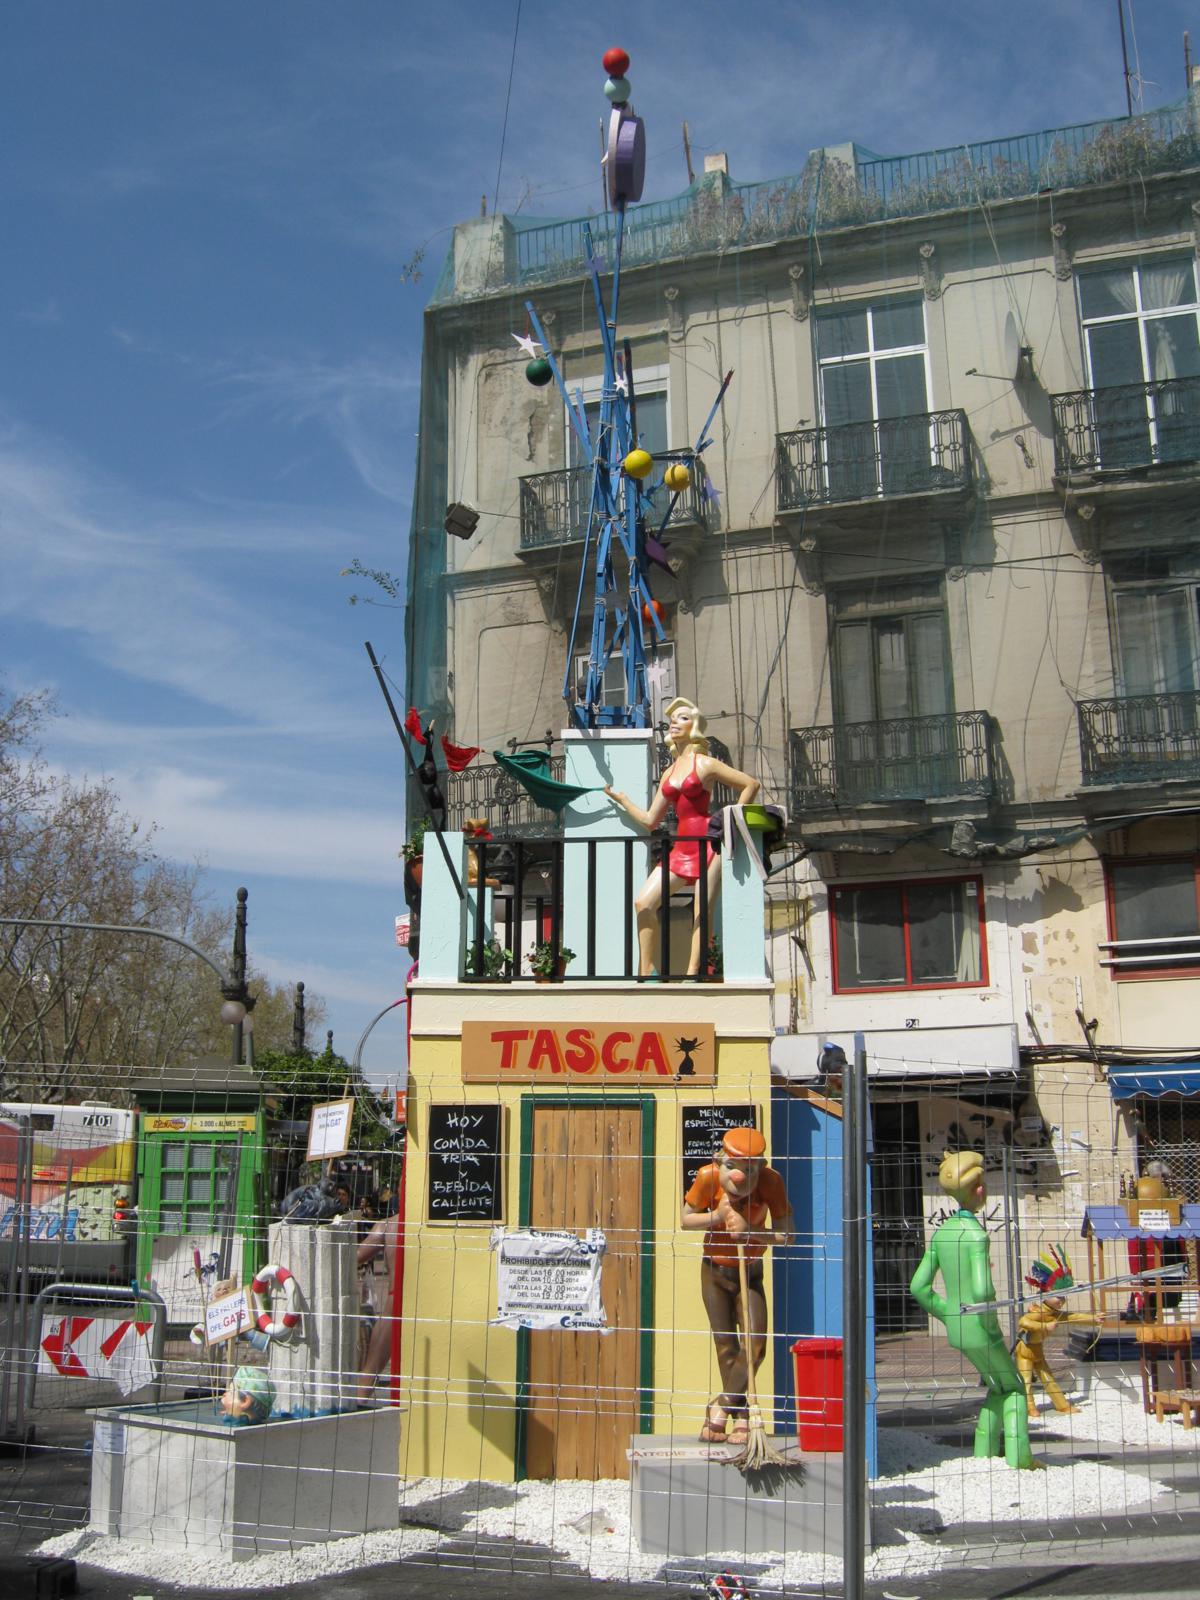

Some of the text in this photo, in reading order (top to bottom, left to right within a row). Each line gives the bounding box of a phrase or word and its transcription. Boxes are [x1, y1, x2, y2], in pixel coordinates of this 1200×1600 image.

[490, 1029, 674, 1075] TASCA
[83, 1114, 112, 1127] 7101
[446, 1112, 484, 1128] HOY
[724, 1119, 754, 1128] FALLAS
[433, 1134, 491, 1150] COMIDA
[432, 1180, 493, 1193] BEBIDA
[431, 1196, 493, 1208] CALIENTE
[501, 1257, 543, 1266] PROHIBIDO
